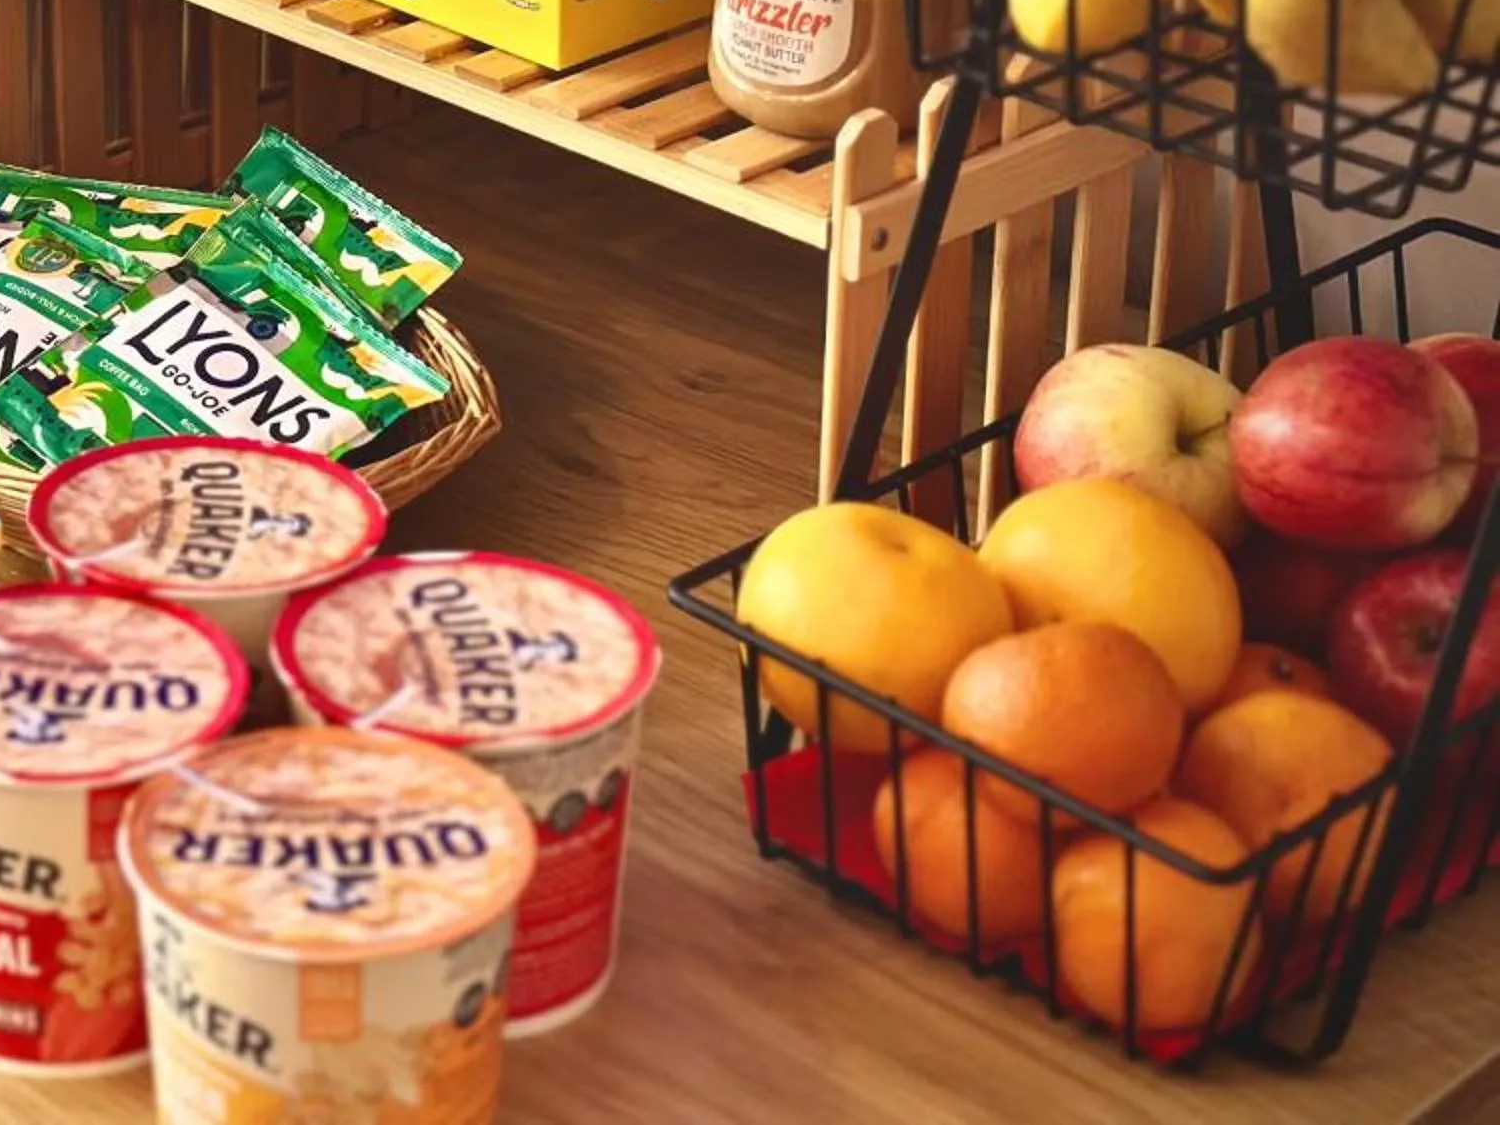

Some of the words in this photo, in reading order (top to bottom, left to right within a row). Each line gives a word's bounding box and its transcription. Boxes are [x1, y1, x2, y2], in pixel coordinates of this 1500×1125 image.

[124, 299, 331, 445] LYONS
[161, 363, 230, 418] GO-JOE
[166, 460, 246, 581] QUAKER
[409, 578, 520, 729] QUAKER
[172, 820, 490, 871] QUAKER
